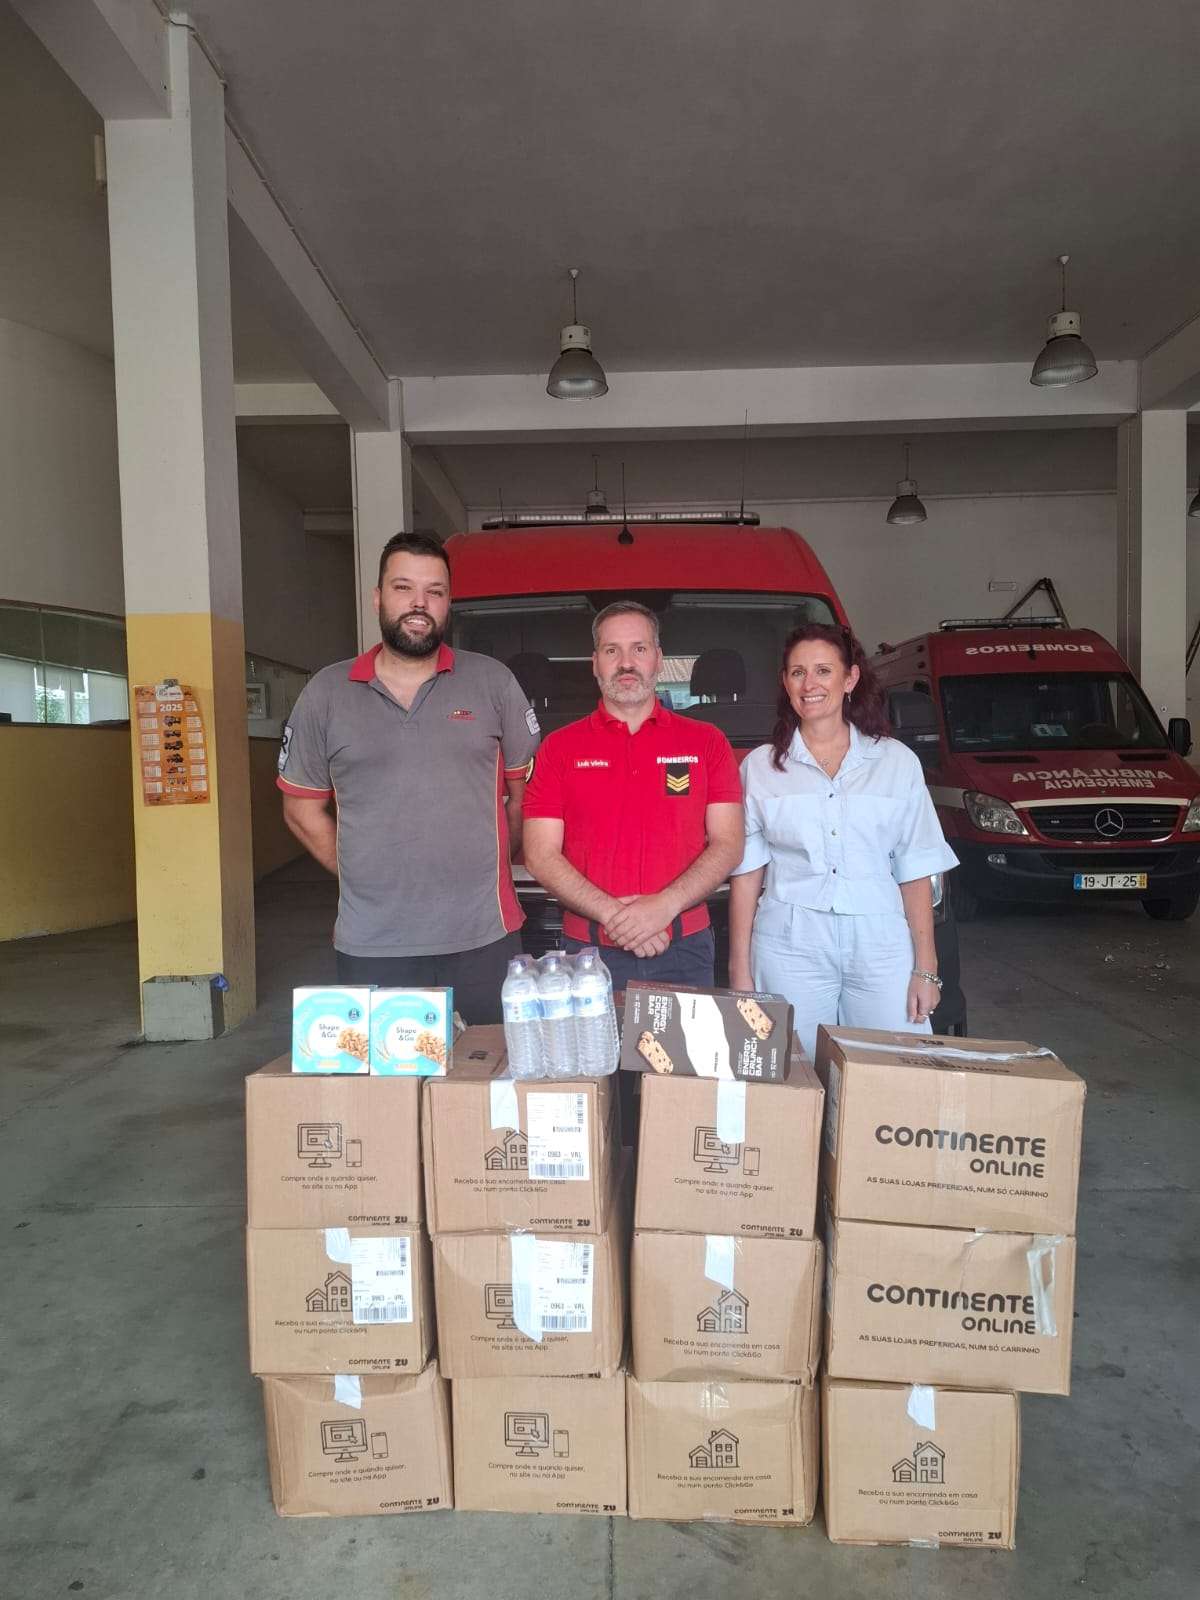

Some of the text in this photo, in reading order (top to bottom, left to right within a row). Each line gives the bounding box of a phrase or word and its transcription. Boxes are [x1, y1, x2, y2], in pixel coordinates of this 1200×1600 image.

[160, 704, 182, 712] 2025
[653, 995, 661, 1034] CRUNCH
[660, 996, 668, 1033] ENERGY
[742, 1038, 750, 1076] ENERGY
[749, 1037, 757, 1076] CRUNCH
[755, 1056, 763, 1077] BAR
[875, 1125, 1046, 1158] CONTINENTE
[970, 1159, 1045, 1178] ONLINE
[902, 1179, 925, 1188] LOJAS
[977, 1186, 995, 1194] NUM
[1009, 1189, 1049, 1198] CARRINHO
[741, 1224, 784, 1232] CONTINENTE
[867, 1283, 1035, 1314] CONTINENTE
[961, 1317, 1036, 1335] ONLINE
[871, 1335, 892, 1343] SUAS
[893, 1337, 918, 1345] LOJAS
[969, 1343, 987, 1351] NUM
[1001, 1346, 1040, 1354] CARRINHO
[379, 1500, 422, 1508] CONTINENTE
